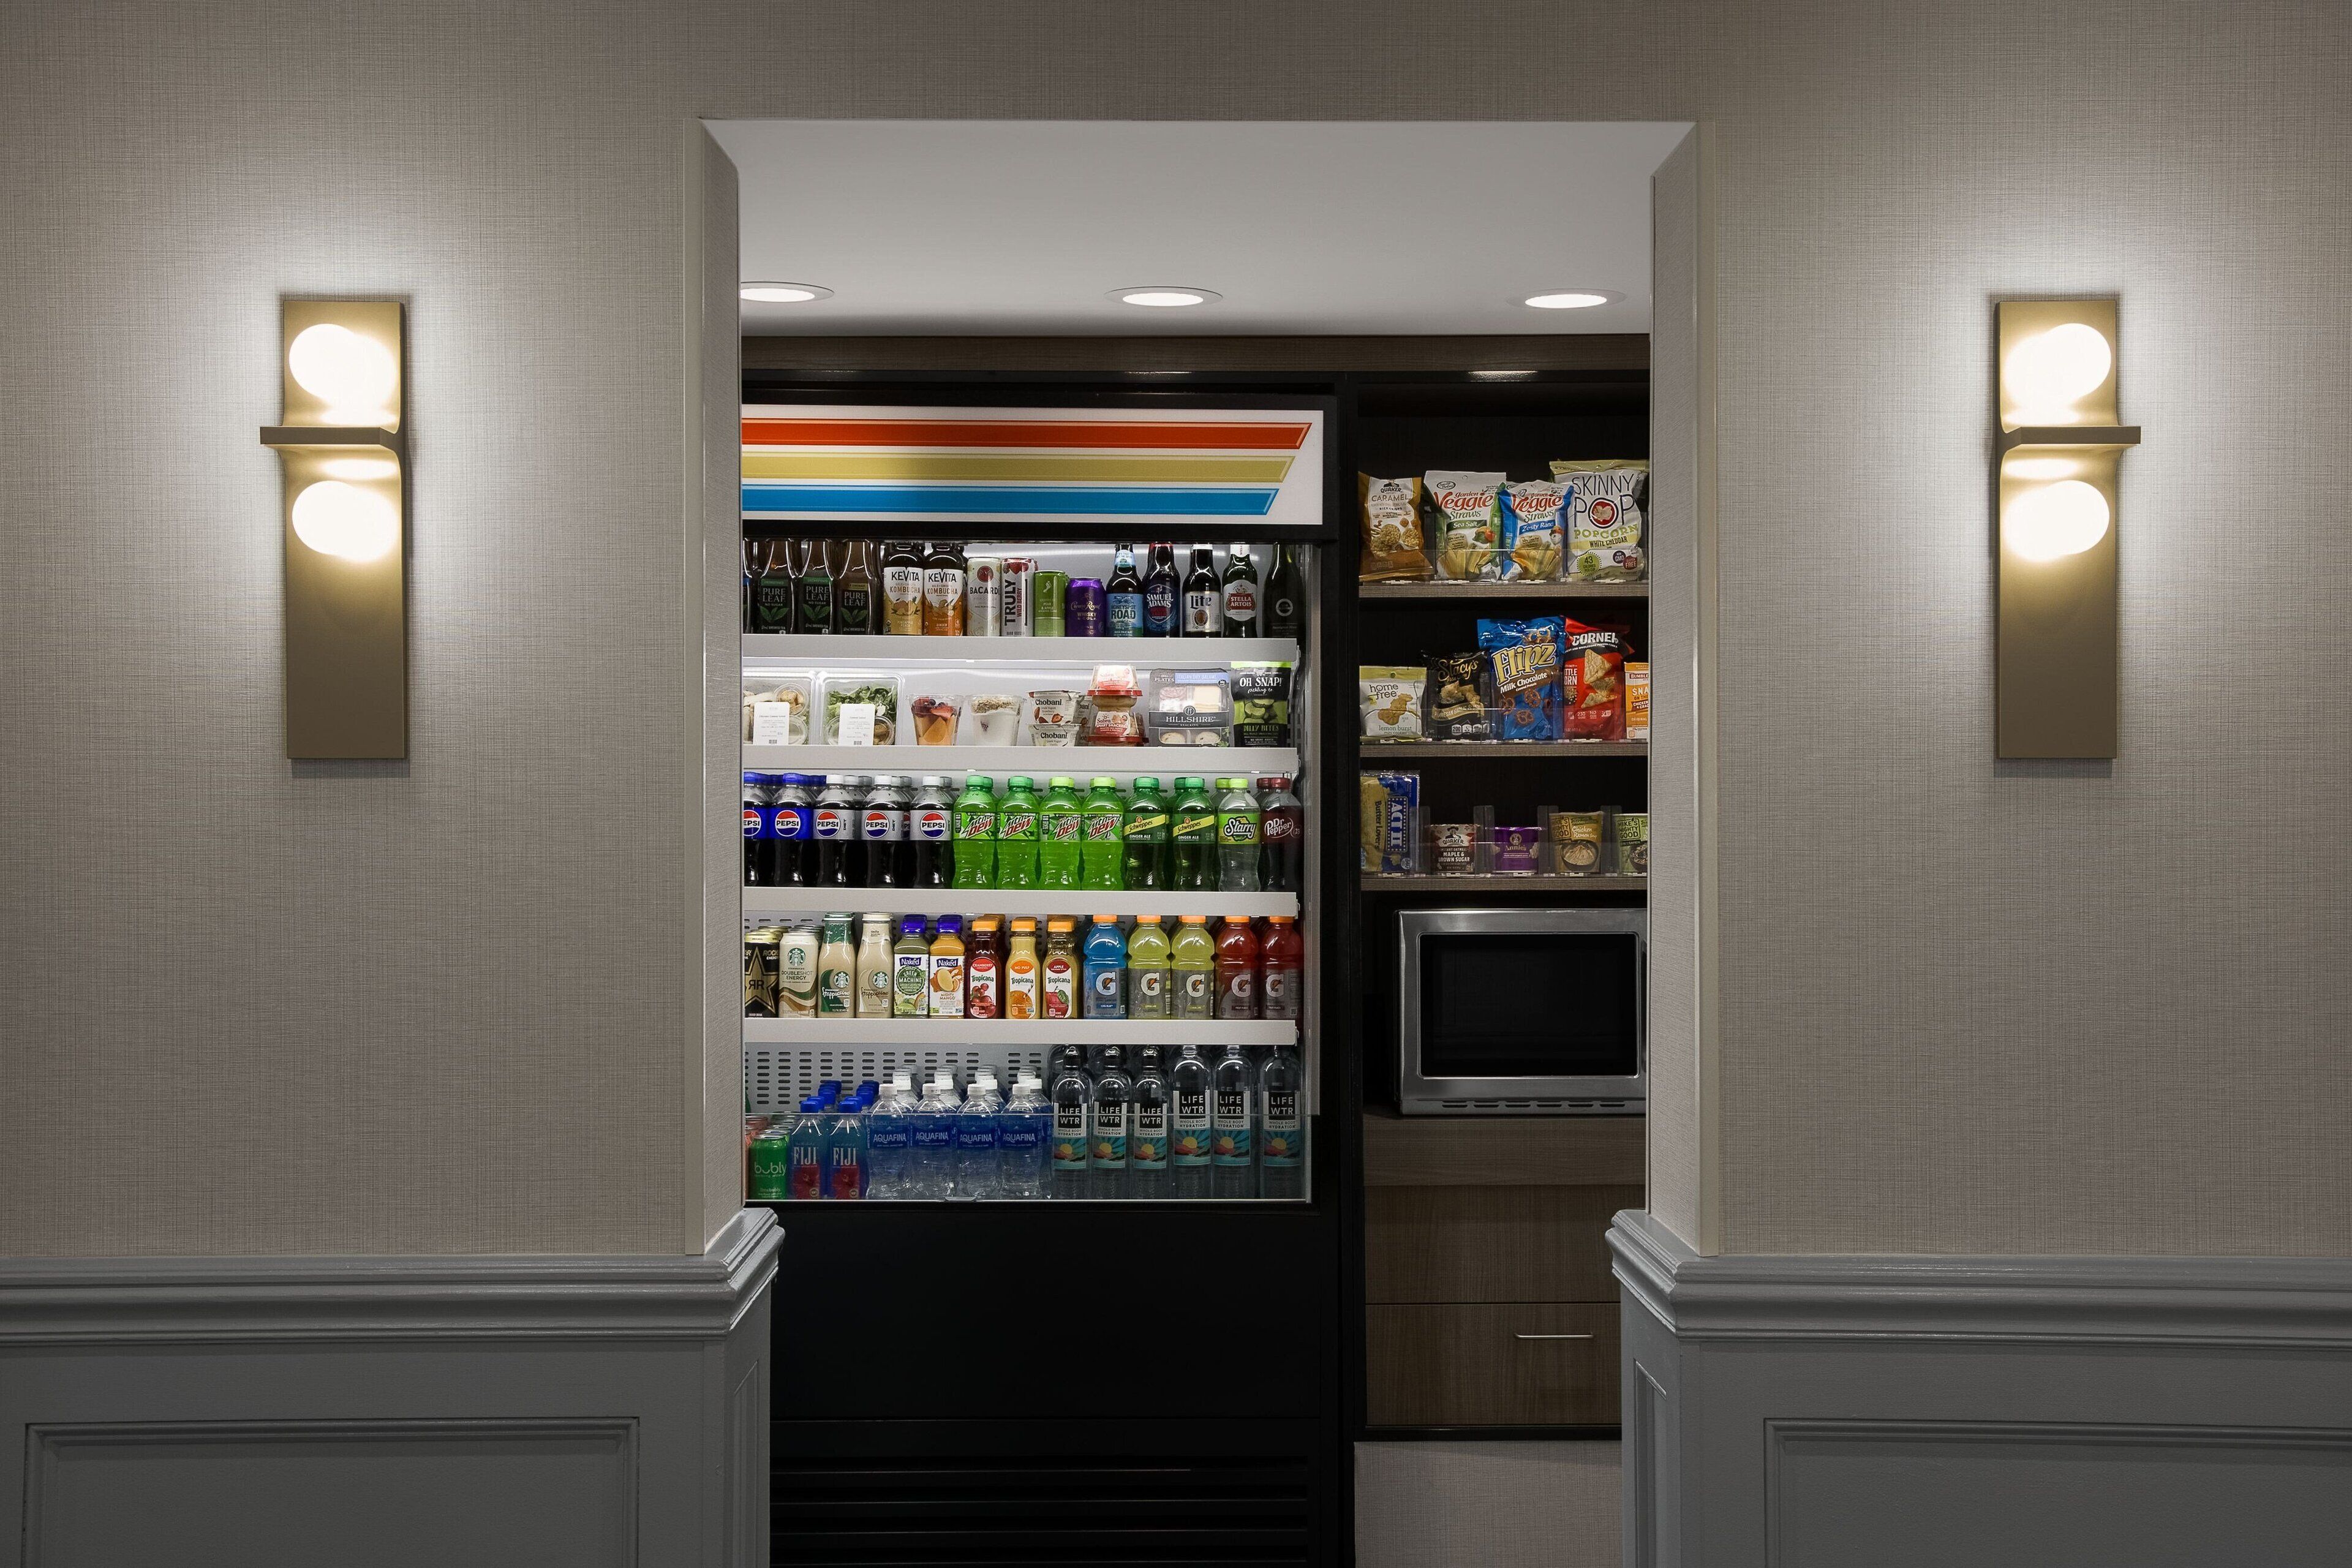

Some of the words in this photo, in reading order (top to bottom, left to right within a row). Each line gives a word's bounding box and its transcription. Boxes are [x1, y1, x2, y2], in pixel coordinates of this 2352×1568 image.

[1572, 473, 1634, 496] SKINNY
[1434, 491, 1494, 511] Veggie
[1512, 494, 1564, 513] Veggie
[1450, 511, 1481, 521] Straws
[1523, 510, 1555, 523] Straws
[1574, 494, 1638, 529] POP
[1574, 524, 1638, 539] POPCORN
[1589, 540, 1605, 548] WHITE
[1605, 537, 1628, 546] CHEDDAR
[891, 570, 920, 582] KEVITA
[928, 571, 957, 583] KEVITA
[1005, 579, 1016, 626] TRULY
[1146, 592, 1174, 601] SAMUEL
[1190, 595, 1212, 610] Lite
[1111, 610, 1136, 620] ROAD
[1438, 659, 1479, 682] Stacy's
[1492, 643, 1556, 685] Flipz
[1239, 677, 1252, 687] OH
[1255, 677, 1282, 687] SNAP!
[1369, 684, 1399, 693] home
[1500, 682, 1516, 694] Milk
[1517, 672, 1548, 687] Chocolate
[1374, 690, 1397, 701] free
[1632, 687, 1649, 696] SNA
[1391, 802, 1403, 829] ACT
[1129, 820, 1153, 832] Schweppes
[1177, 821, 1202, 834] Schweppes
[1224, 818, 1256, 839] Starry
[1265, 820, 1292, 836] Pepper
[1011, 976, 1034, 985] Tropicana
[1096, 971, 1117, 995] G
[1140, 972, 1160, 996] G
[1186, 974, 1205, 997] G
[1231, 974, 1251, 997] G
[1266, 974, 1284, 997] G
[873, 1133, 907, 1144] AQUAFINA
[916, 1132, 949, 1142] AQUAFINA
[960, 1133, 993, 1144] AQUAFINA
[1003, 1133, 1037, 1143] AQUAFINA
[793, 1147, 818, 1164] FIJI
[833, 1147, 856, 1166] FIJI
